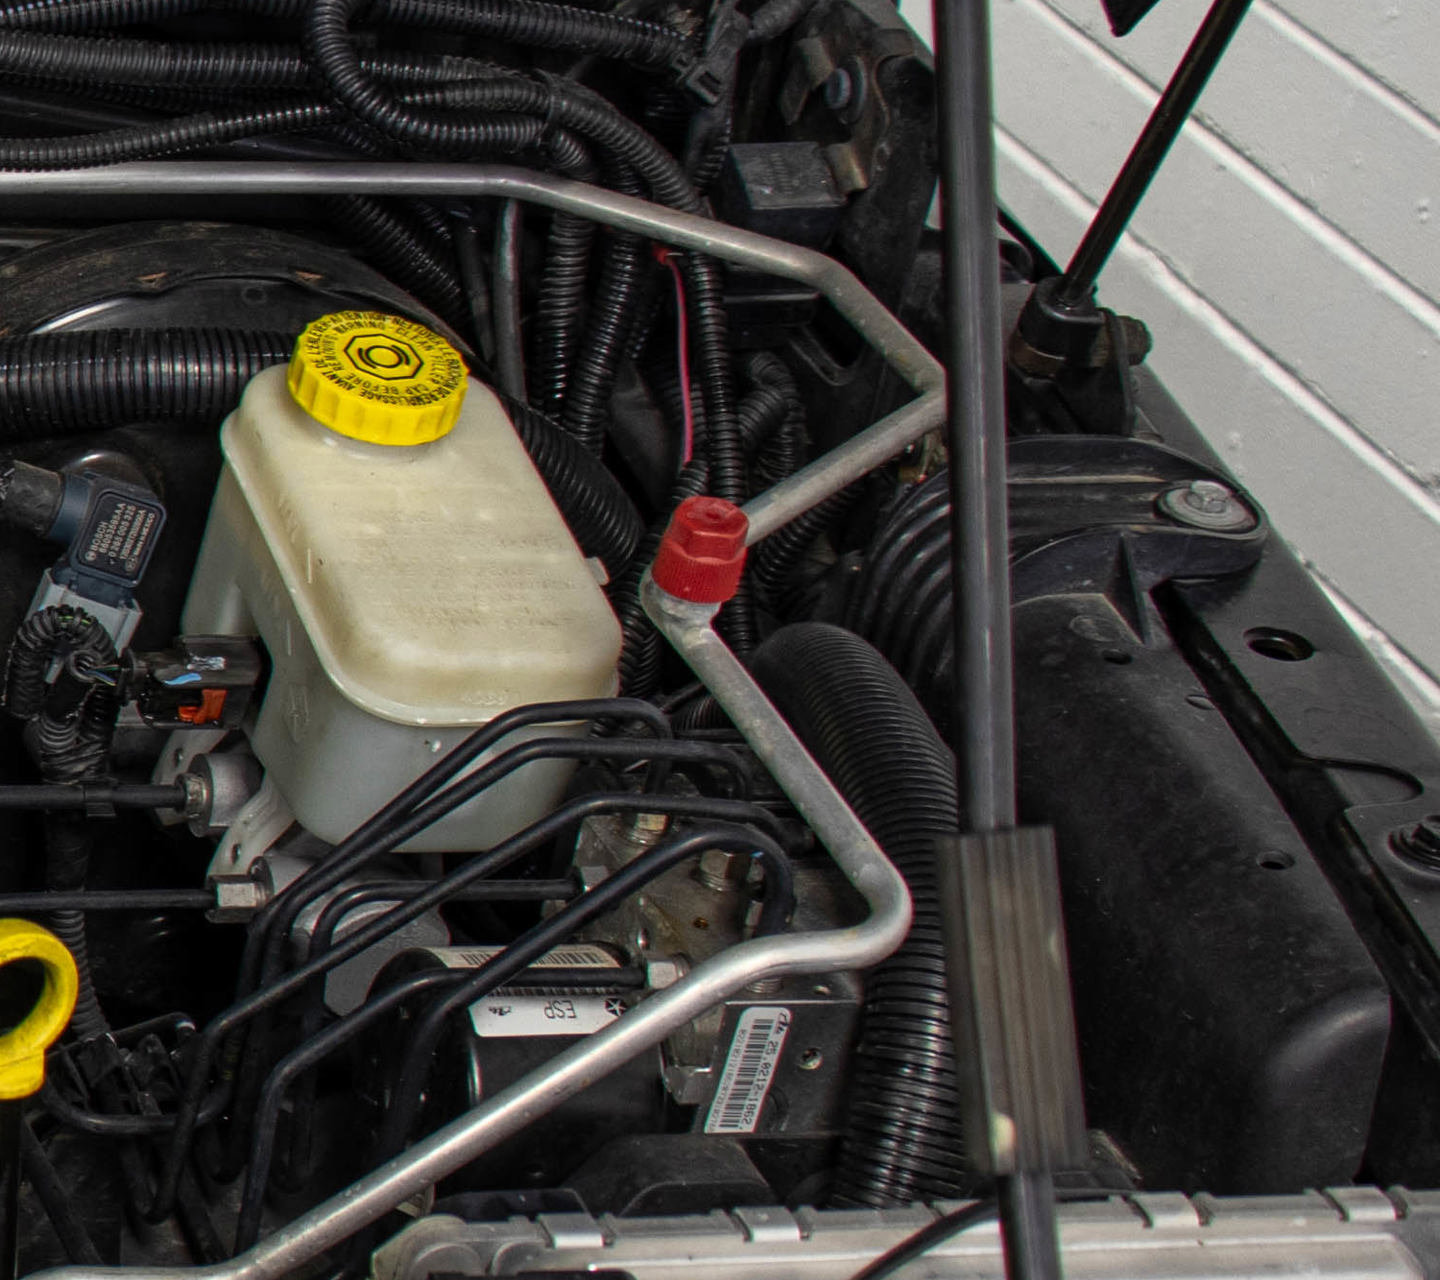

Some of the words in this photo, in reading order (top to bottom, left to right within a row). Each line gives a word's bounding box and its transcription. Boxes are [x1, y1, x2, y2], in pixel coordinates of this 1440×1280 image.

[332, 322, 384, 333] WARNING
[397, 327, 435, 351] CLEAN
[344, 374, 400, 395] BEFORE
[90, 520, 108, 552] BOSCH
[543, 999, 577, 1019] ESP
